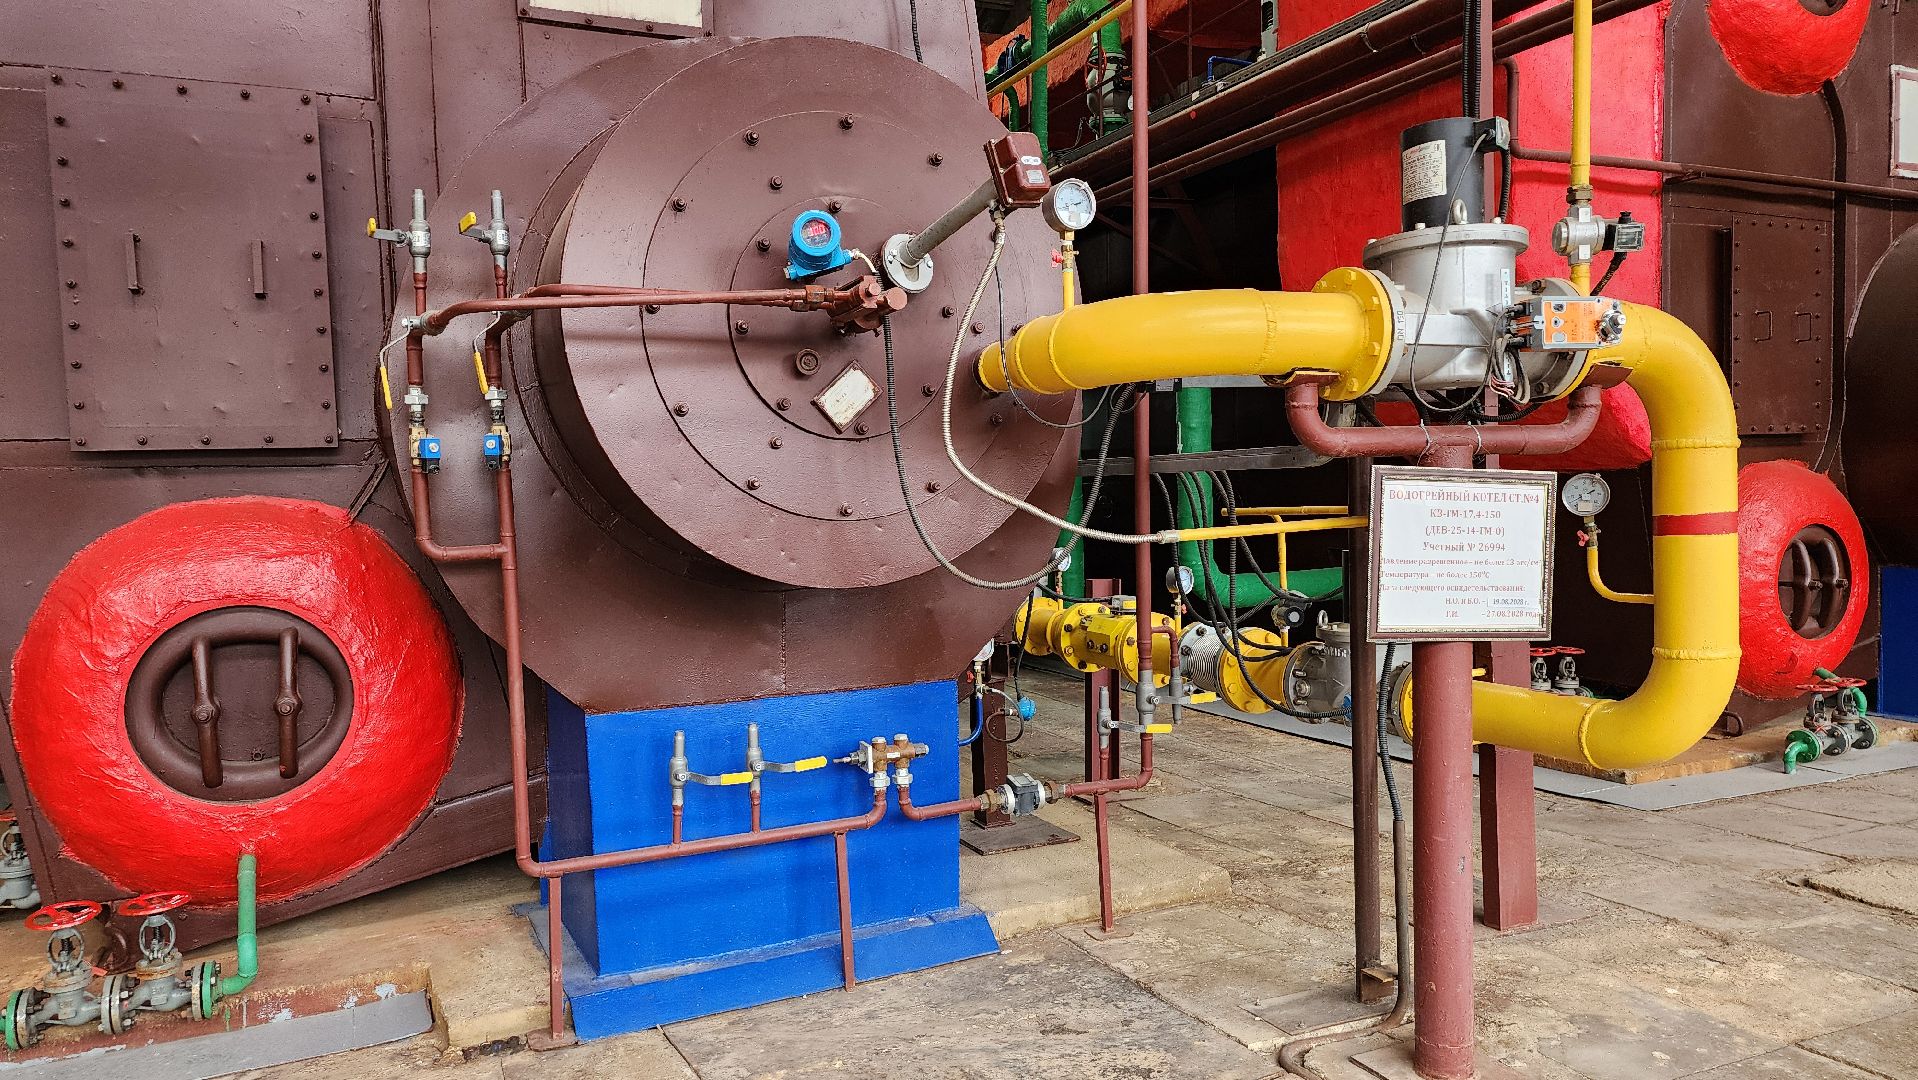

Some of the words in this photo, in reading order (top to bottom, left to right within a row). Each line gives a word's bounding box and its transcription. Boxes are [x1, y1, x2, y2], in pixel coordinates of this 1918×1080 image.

[1397, 328, 1405, 341] DN
[1389, 488, 1470, 502] ВОДОГРЕЙНЫЙ
[1472, 492, 1507, 503] КОТЕЛ
[1478, 542, 1506, 552] 26994
[1380, 571, 1429, 580] Температура
[1399, 584, 1445, 593] следующего
